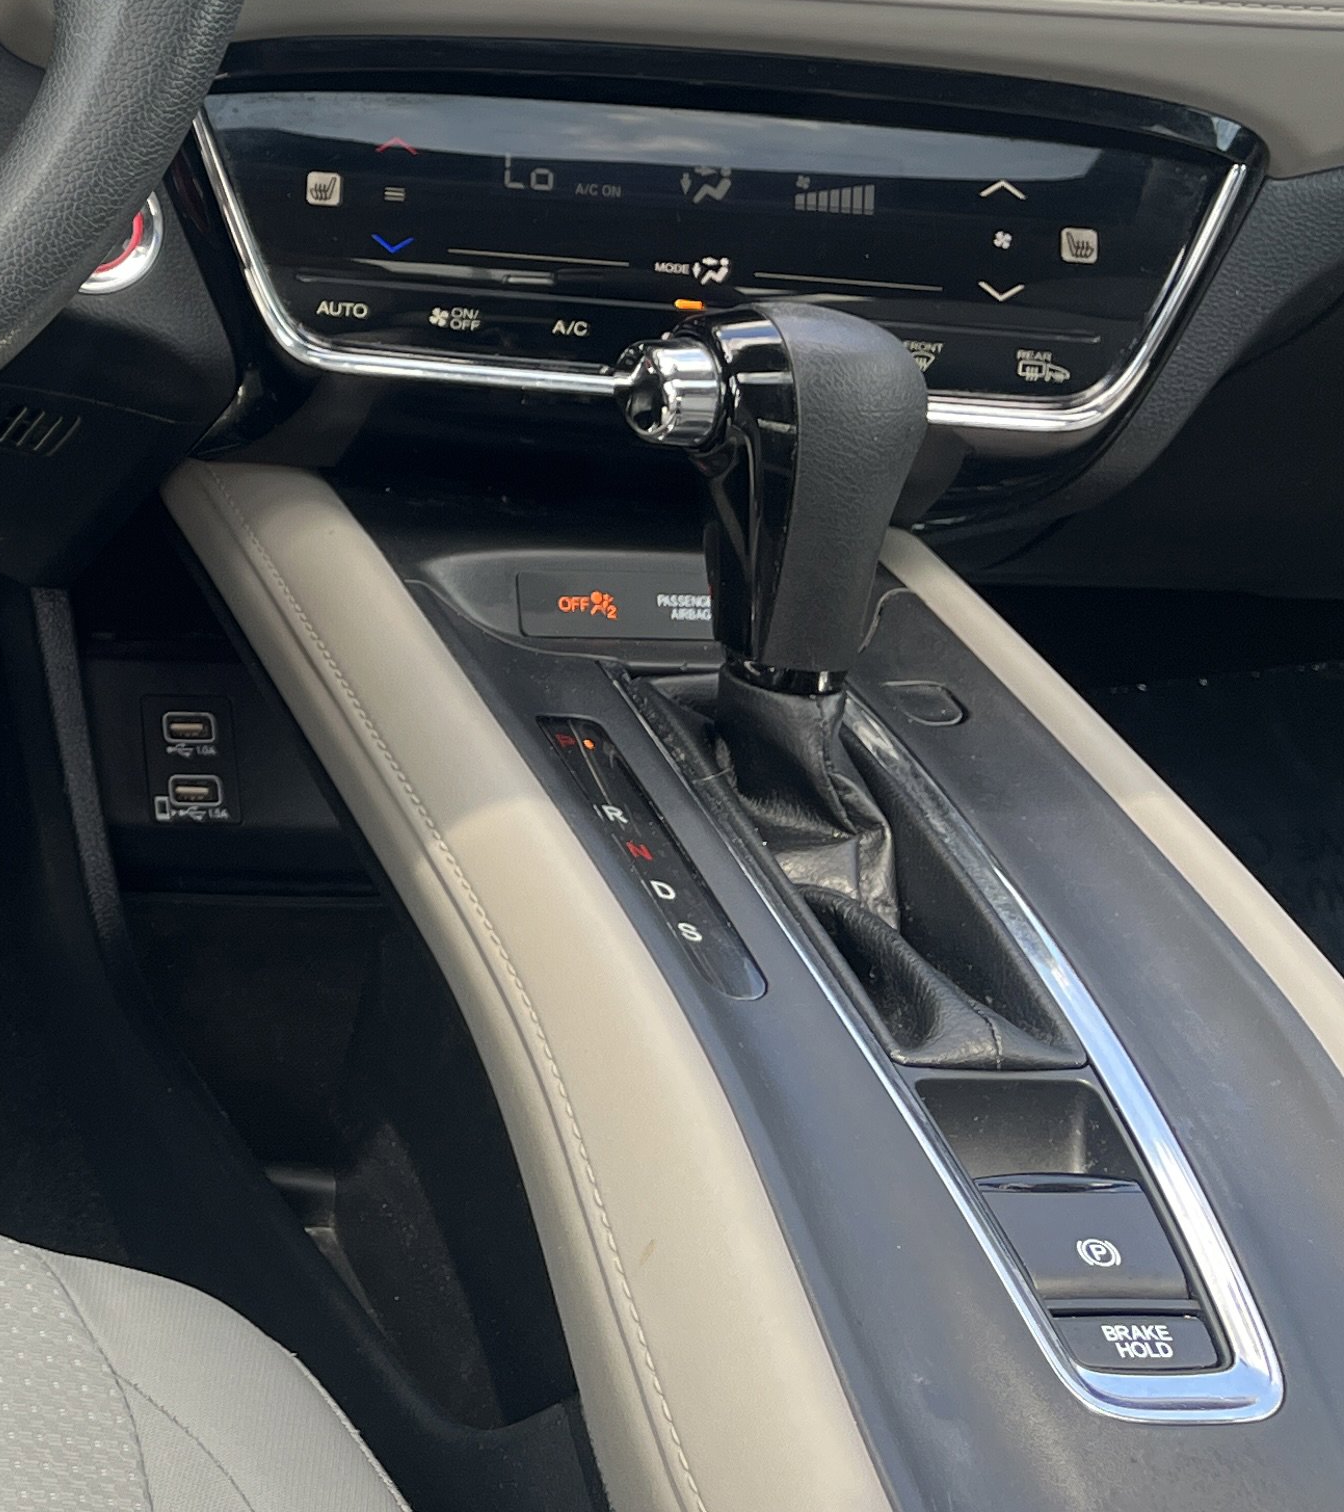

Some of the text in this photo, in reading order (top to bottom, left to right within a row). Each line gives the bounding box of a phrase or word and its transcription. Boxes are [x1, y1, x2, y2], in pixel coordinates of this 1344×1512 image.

[655, 262, 690, 275] MODE
[316, 300, 369, 321] AUTO
[450, 307, 480, 321] ON/
[450, 318, 481, 332] OFF
[552, 319, 590, 337] A/C
[1016, 349, 1052, 362] REAR
[558, 595, 590, 613] OFF
[657, 593, 711, 609] PASSENG
[601, 803, 629, 826] R
[625, 839, 654, 862] N
[650, 880, 677, 901] D
[677, 921, 703, 943] S
[1101, 1324, 1173, 1342] BRAKE
[1115, 1342, 1174, 1359] HOLD
